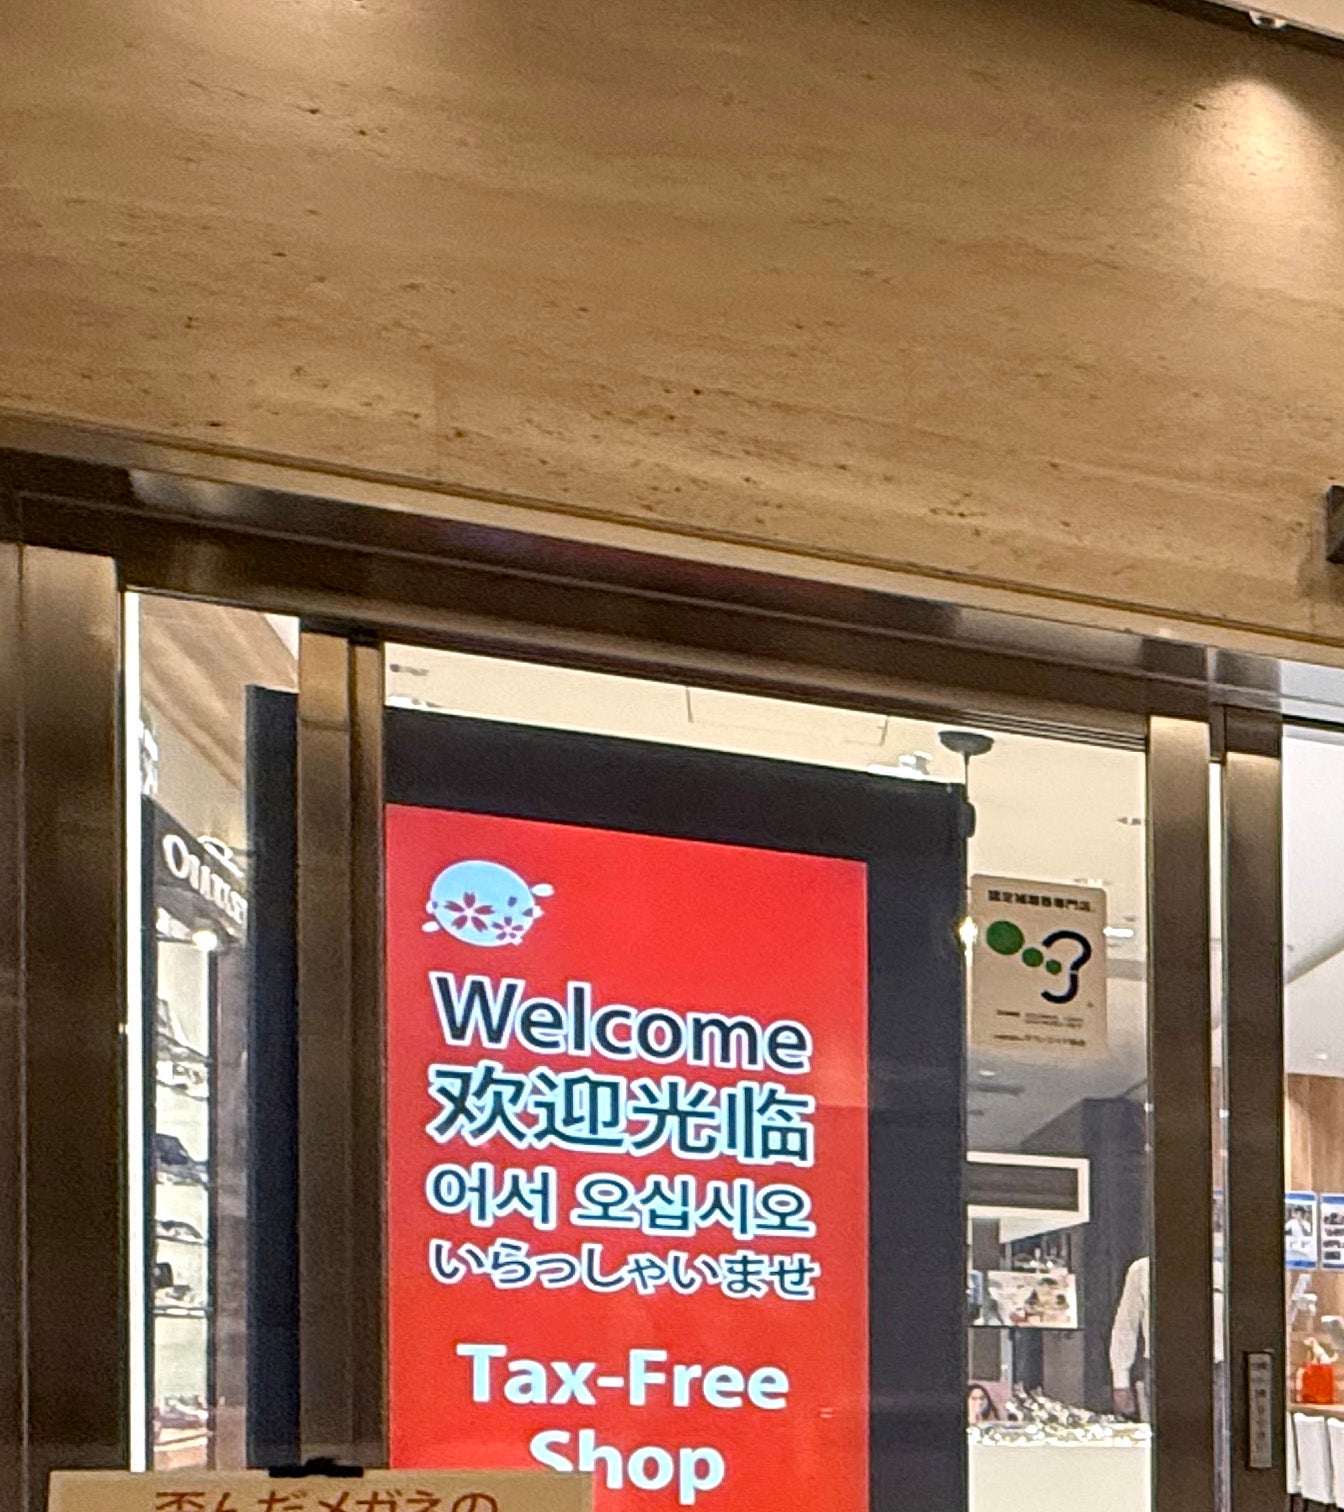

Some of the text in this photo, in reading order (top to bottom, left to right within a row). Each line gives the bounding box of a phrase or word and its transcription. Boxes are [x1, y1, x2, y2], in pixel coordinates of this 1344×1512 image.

[429, 971, 812, 1073] Welcome
[427, 1060, 815, 1167] 欢迎光临
[426, 1165, 816, 1238] 어서 오십시오
[429, 1238, 820, 1300] いらっしゃいませ
[456, 1344, 789, 1409] Tax-Free
[530, 1429, 725, 1506] Shop
